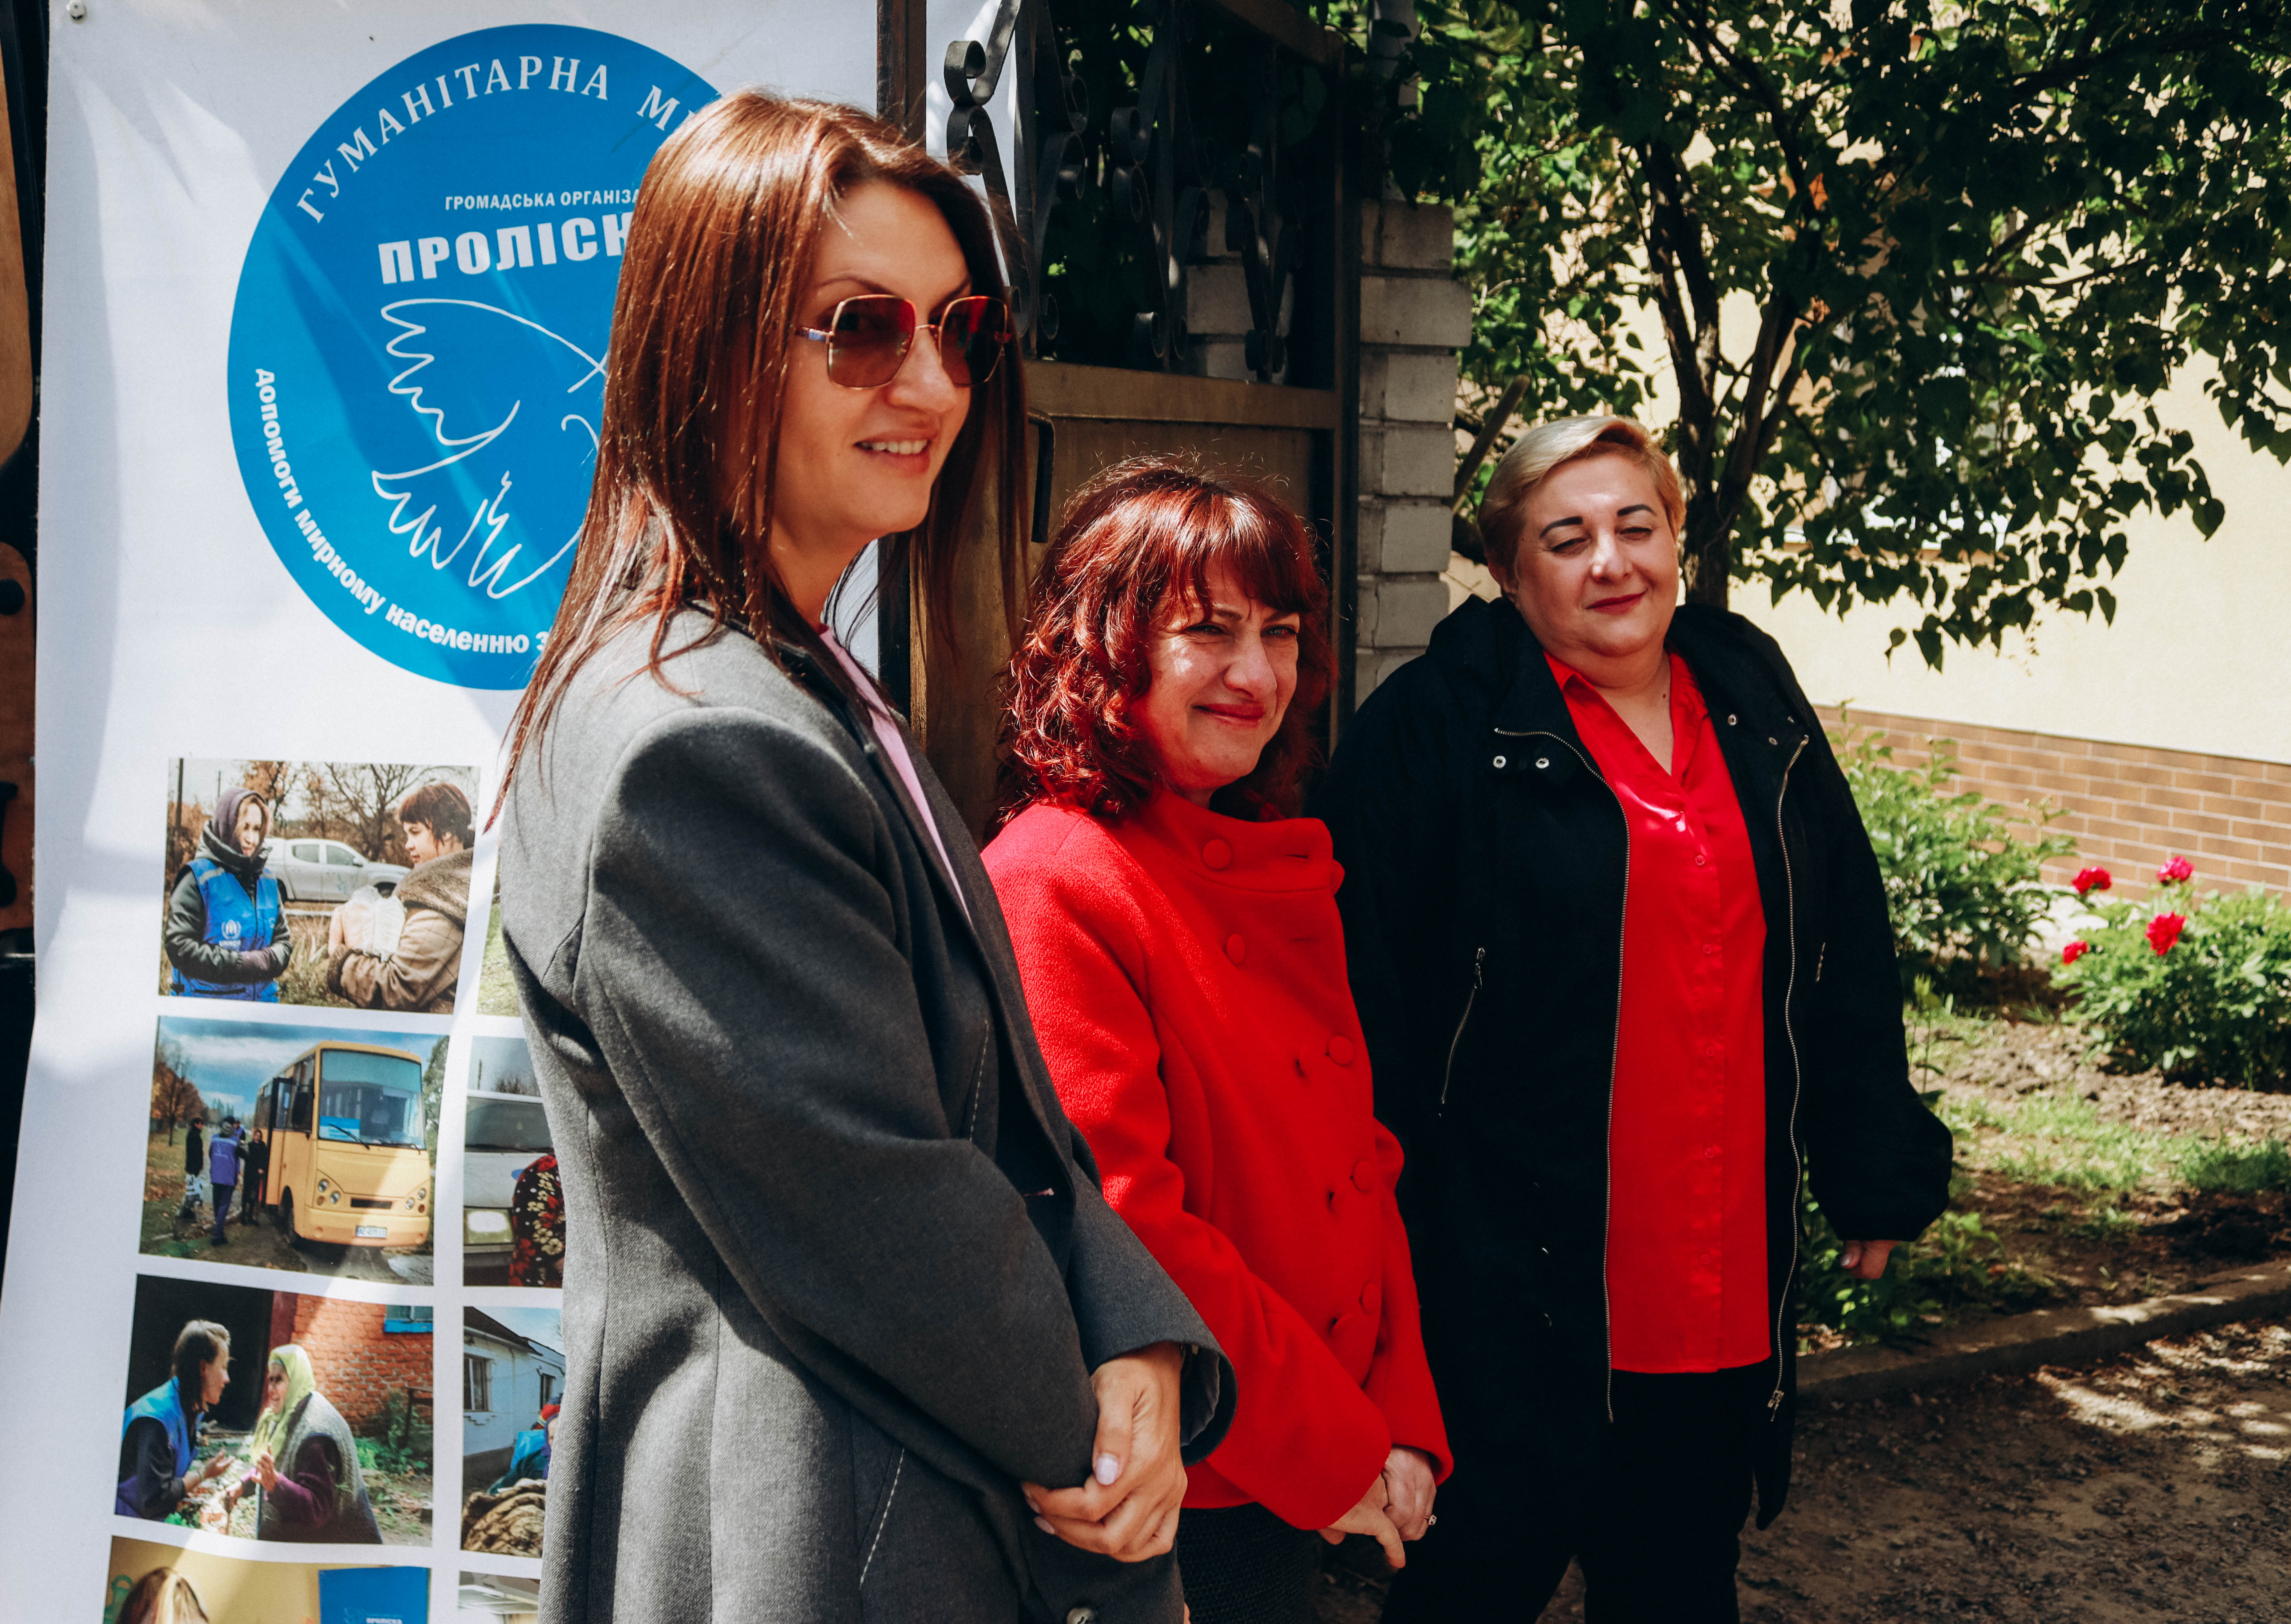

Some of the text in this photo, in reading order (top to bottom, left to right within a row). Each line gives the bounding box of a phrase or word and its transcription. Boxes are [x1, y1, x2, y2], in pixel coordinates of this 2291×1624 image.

[297, 56, 696, 222] ГУМАНІТАРНА М
[445, 192, 555, 210] ГРОМАДСЬКА
[255, 368, 303, 509] допомоги
[294, 508, 386, 615] мирному
[385, 603, 530, 654] населенню
